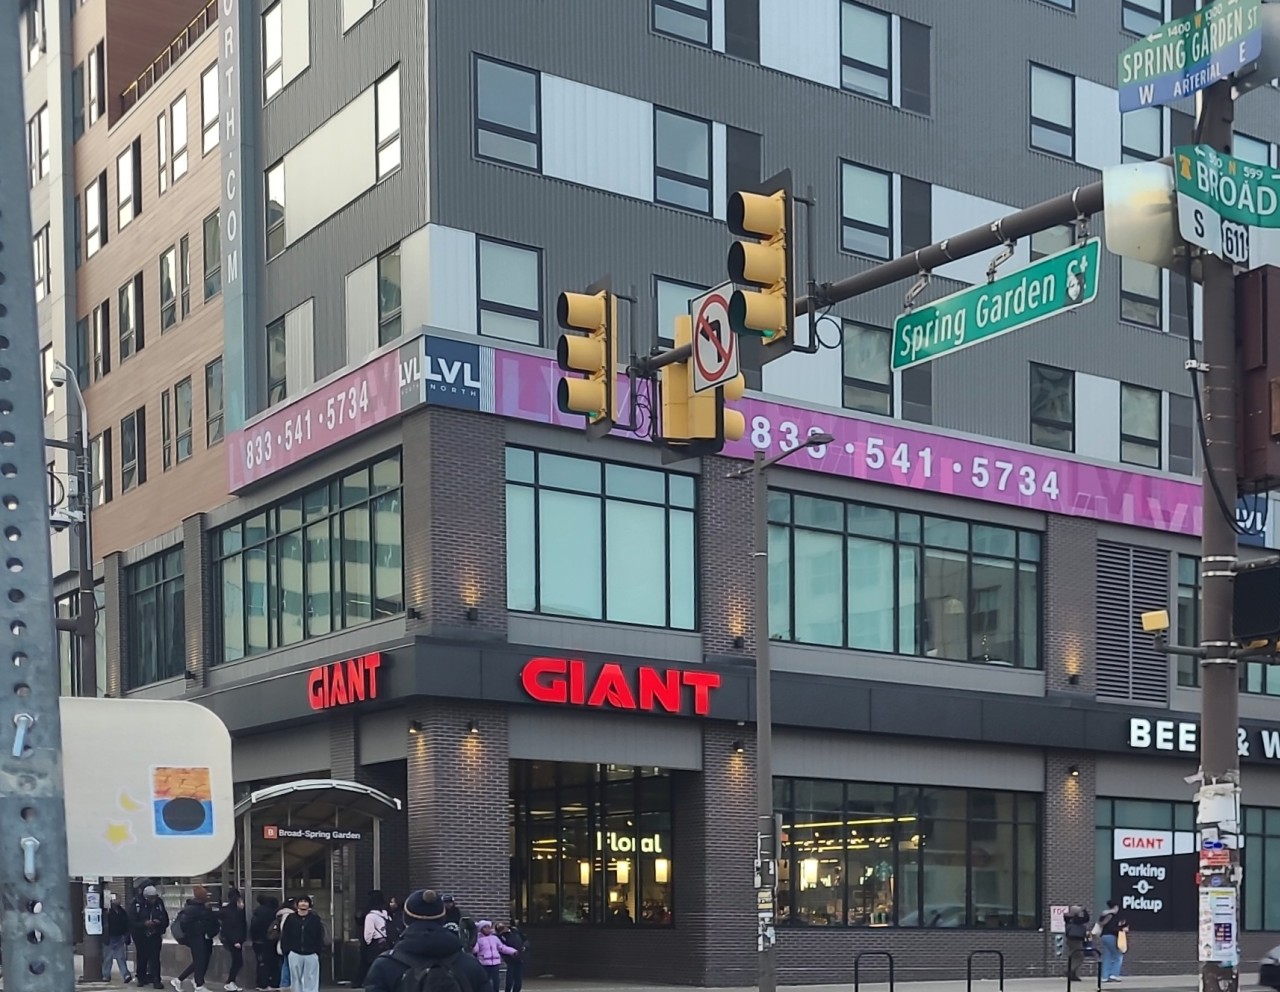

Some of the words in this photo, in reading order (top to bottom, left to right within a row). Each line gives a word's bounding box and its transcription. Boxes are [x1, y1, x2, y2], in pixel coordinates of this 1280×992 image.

[1123, 38, 1186, 83] SPRING
[1192, 12, 1243, 62] GARDEN
[1247, 7, 1258, 30] ST
[1167, 21, 1191, 37] 1400
[1139, 84, 1154, 105] W
[1173, 63, 1221, 97] ARTERIAL
[1239, 41, 1246, 63] E
[1228, 160, 1237, 176] N
[1243, 167, 1263, 180] 599
[1196, 160, 1278, 216] BROAD
[1194, 209, 1204, 238] S
[1225, 228, 1246, 259] 611
[900, 307, 966, 360] Spring
[976, 276, 1055, 329] Garden
[400, 357, 420, 387] LVL
[425, 355, 481, 388] LVL
[430, 384, 476, 397] NORTH
[307, 652, 382, 710] GIANT
[521, 657, 721, 716] GIANT
[1129, 717, 1197, 752] BEE
[279, 829, 331, 839] Broad-Spring
[332, 831, 361, 839] Garden
[1122, 837, 1164, 849] GIANT
[1120, 863, 1166, 881] Parking
[1123, 896, 1163, 913] Pickup
